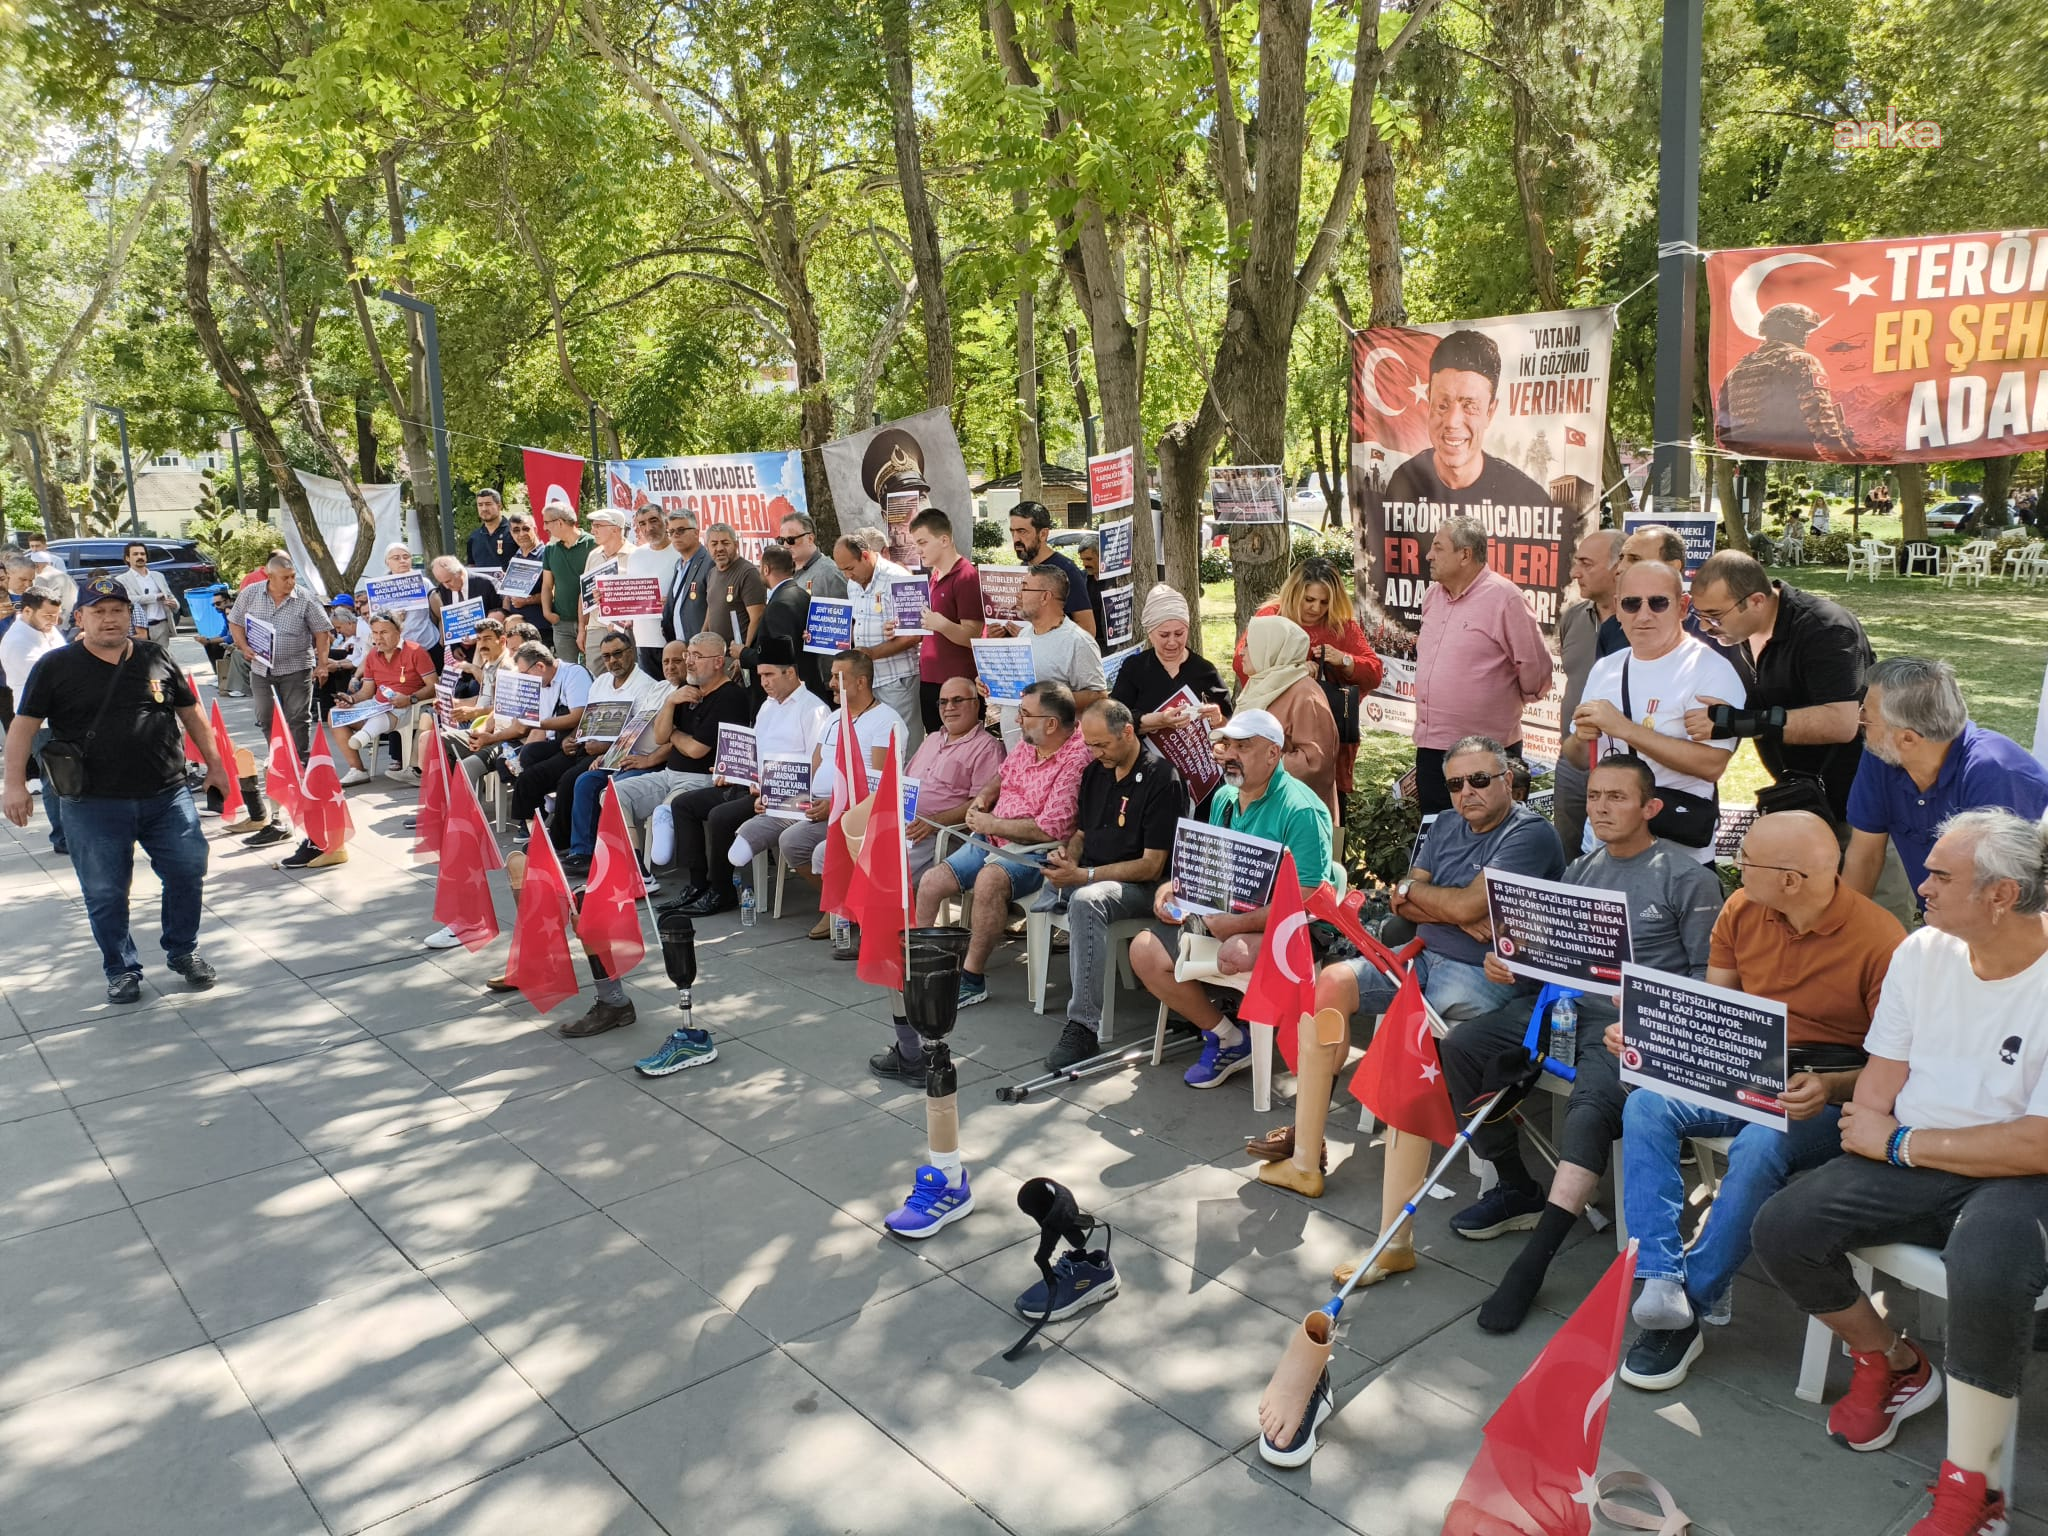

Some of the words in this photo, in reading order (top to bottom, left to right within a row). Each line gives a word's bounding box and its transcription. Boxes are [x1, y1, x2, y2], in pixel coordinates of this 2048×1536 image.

[1872, 308, 1933, 373] ER
[1519, 352, 1535, 377] İKİ
[1540, 349, 1590, 375] GÖZÜMÜ
[644, 465, 693, 492] TERÖRLE
[693, 463, 756, 490] MÜCADELE
[1384, 537, 1419, 575] ER
[1488, 539, 1559, 587] İLERİ
[720, 755, 737, 763] NEDEN
[788, 764, 808, 773] GAZİLER
[1169, 733, 1188, 757] OLUR
[1184, 756, 1198, 775] MU?
[764, 779, 790, 789] AYRIMCILIK
[790, 782, 808, 790] KABUL
[773, 772, 797, 780] ARASINDA
[1208, 847, 1237, 860] ÖNÜNDE
[1238, 856, 1274, 870] SAVAŞTIK!
[1234, 844, 1263, 857] BIRAKIP
[1191, 854, 1248, 874] KOMUTANLARIMIZ
[1249, 868, 1264, 879] GİBİ
[1195, 865, 1204, 873] BİR
[1205, 868, 1234, 881] GELECEĞİ
[1235, 875, 1260, 888] VATAN
[1217, 881, 1251, 897] BIRAKTIK!
[1494, 882, 1503, 891] ER
[1504, 884, 1526, 896] ŞEHİT
[1527, 890, 1537, 899] VE
[1539, 893, 1578, 908] GAZİLERE
[1580, 900, 1592, 909] DE
[1594, 901, 1623, 914] DİĞER
[1494, 893, 1518, 905] KAMU
[1520, 899, 1570, 917] GÖREVLİLERİ
[1573, 910, 1591, 921] GİBİ
[1594, 915, 1625, 926] EMSAL
[1501, 905, 1525, 917] STATÜ
[1526, 912, 1576, 930] TANINMALI,
[1578, 922, 1588, 930] 32
[1590, 925, 1620, 936] YILLIK
[1504, 916, 1541, 932] EŞİTSİZLİK
[1544, 926, 1554, 936] VE
[1555, 929, 1617, 947] ADALETSİZLİK
[1510, 928, 1548, 944] ORTADAN
[1549, 940, 1615, 958] KALDIRILMALI!
[1528, 947, 1544, 957] ŞEHİT
[1554, 953, 1581, 965] GAZİLER
[1532, 957, 1568, 970] PLATFORMU
[1632, 980, 1642, 990] 32
[1644, 983, 1670, 999] YILLIK
[1672, 991, 1717, 1011] EŞİTSİZLİK
[1719, 1004, 1773, 1026] NEDENİYLE
[1659, 1000, 1670, 1010] ER
[1672, 1003, 1693, 1016] GAZİ
[1694, 1009, 1743, 1031] SORUYOR:
[1637, 1005, 1667, 1020] BENİM
[1668, 1012, 1687, 1026] KÖR
[1689, 1021, 1716, 1035] OLAN
[1717, 1028, 1767, 1049] GÖZLERİM
[1639, 1017, 1693, 1040] RÜTBELİNİN
[1694, 1033, 1762, 1060] GÖZLERİNDEN
[1624, 1035, 1637, 1046] BU
[1638, 1040, 1696, 1066] AYRIMCILIĞA
[1697, 1058, 1725, 1074] ARTIK
[1726, 1067, 1748, 1081] SON
[1749, 1073, 1783, 1090] VERİN!
[1650, 1032, 1676, 1047] DAHA
[1677, 1041, 1689, 1050] MI
[1691, 1044, 1750, 1069] DEĞERSİZDİ?
[1652, 1059, 1661, 1067] ER
[1662, 1062, 1683, 1075] ŞEHİT
[1685, 1068, 1694, 1078] VE
[1696, 1072, 1727, 1088] GAZİLER
[1667, 1073, 1710, 1091] PLATFORMU
